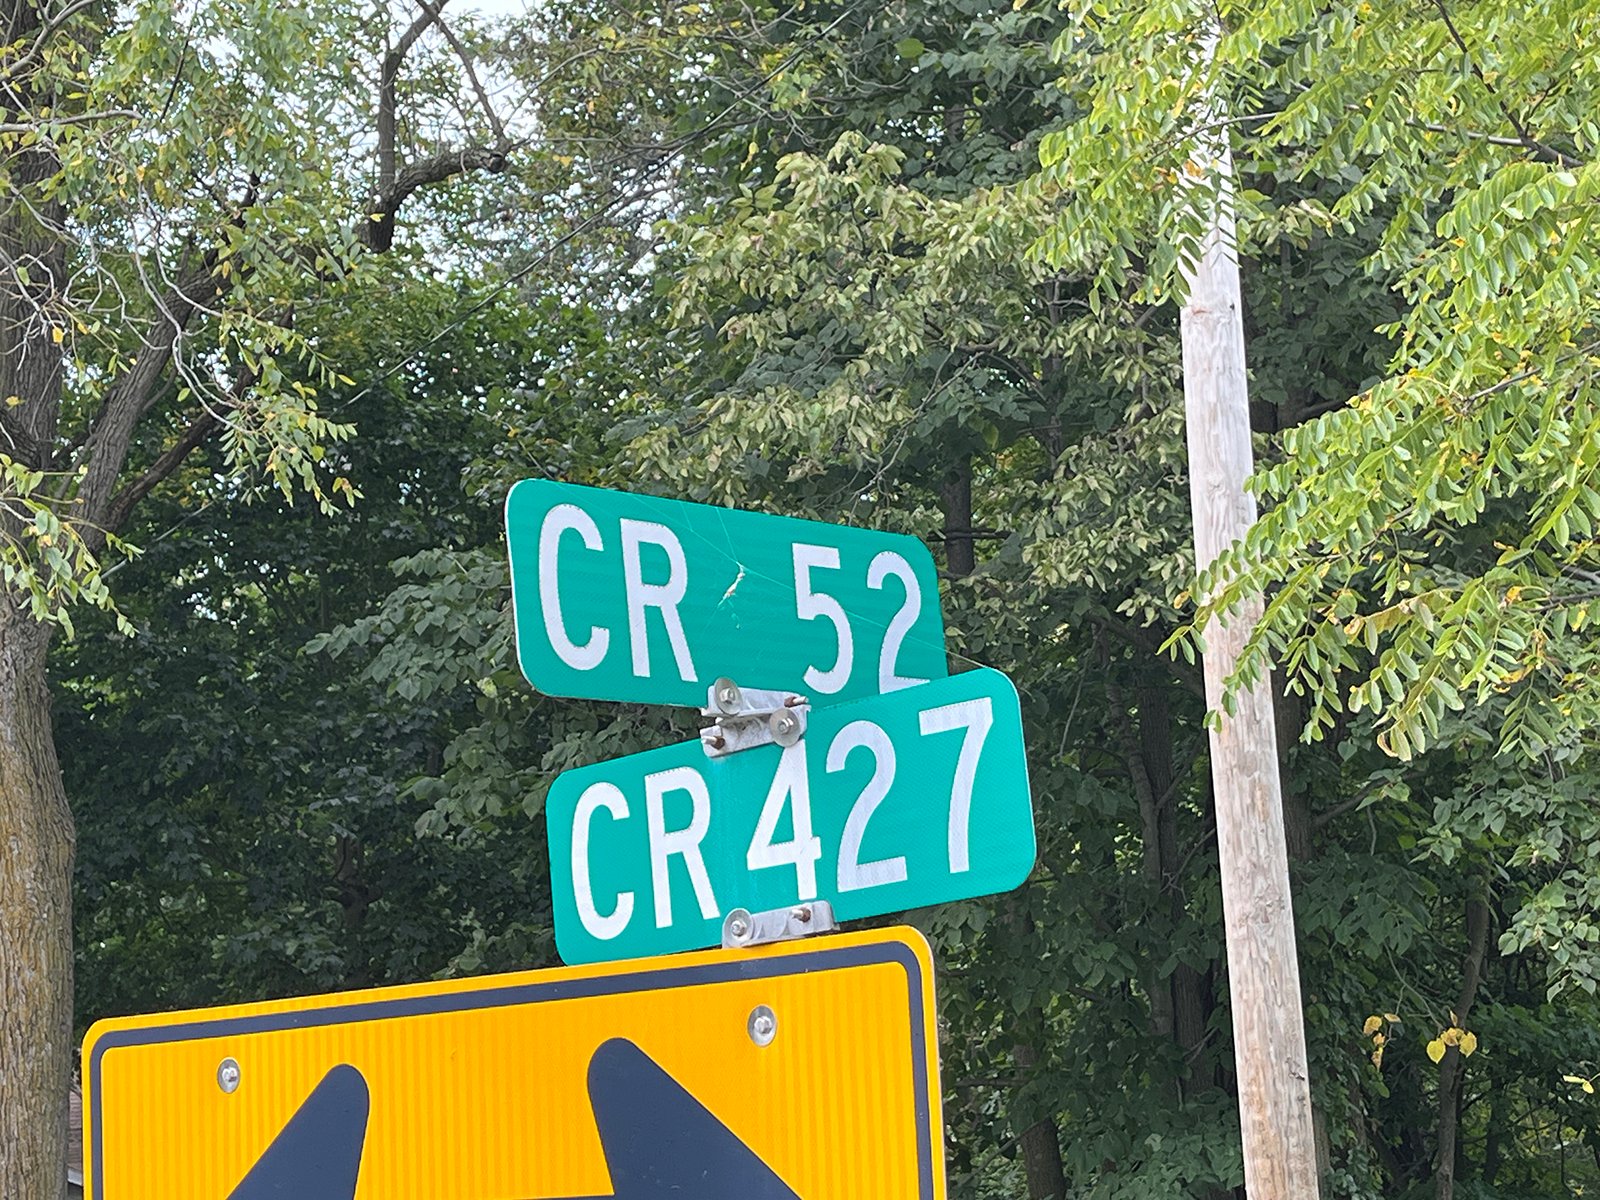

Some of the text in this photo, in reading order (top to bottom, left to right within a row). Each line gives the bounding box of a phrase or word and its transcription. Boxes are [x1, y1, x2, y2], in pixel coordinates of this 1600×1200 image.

[538, 504, 931, 694] CR 52
[571, 697, 993, 940] CR 427
